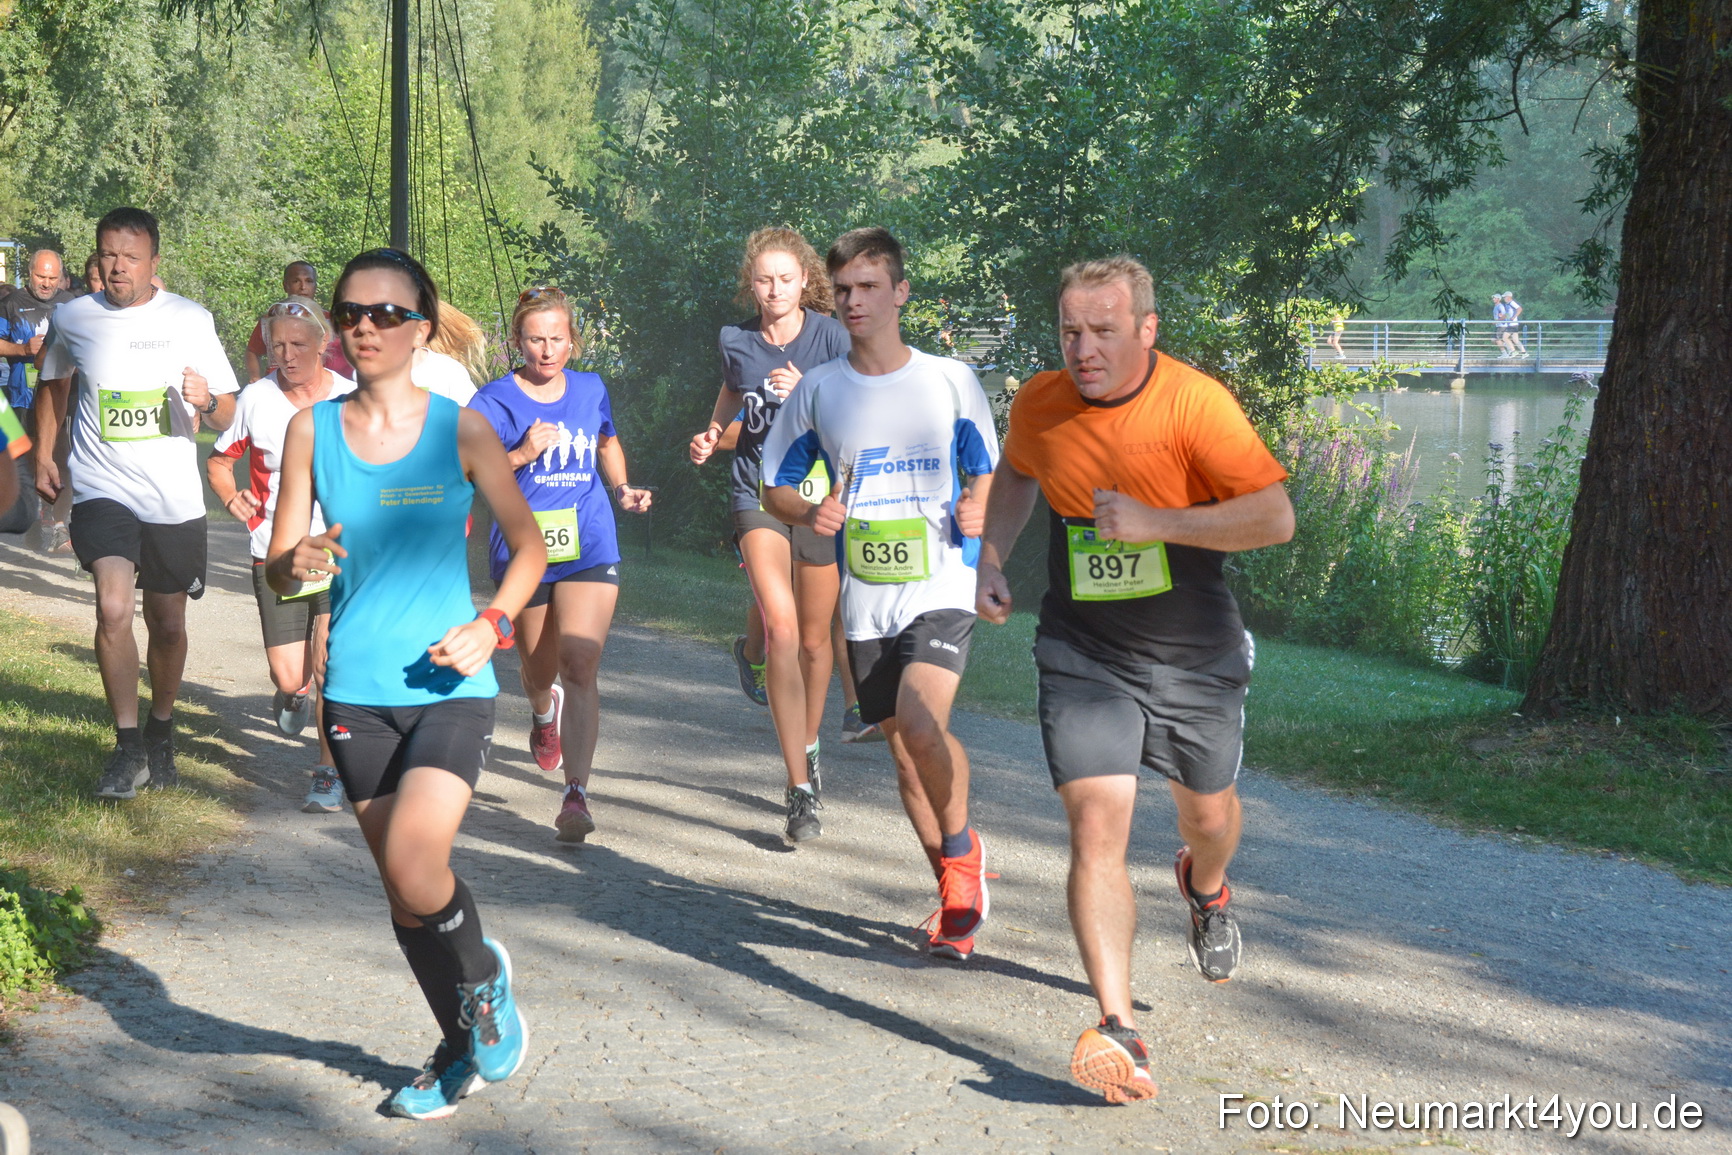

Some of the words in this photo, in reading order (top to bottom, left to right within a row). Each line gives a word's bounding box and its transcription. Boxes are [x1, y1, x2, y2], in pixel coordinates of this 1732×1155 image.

[130, 340, 170, 350] ROBERT
[108, 406, 160, 428] 2091
[534, 472, 592, 484] GEMEINSAM
[402, 497, 444, 505] Blendinger
[862, 542, 909, 564] 636
[1088, 553, 1141, 580] 897
[1123, 579, 1144, 587] Peter
